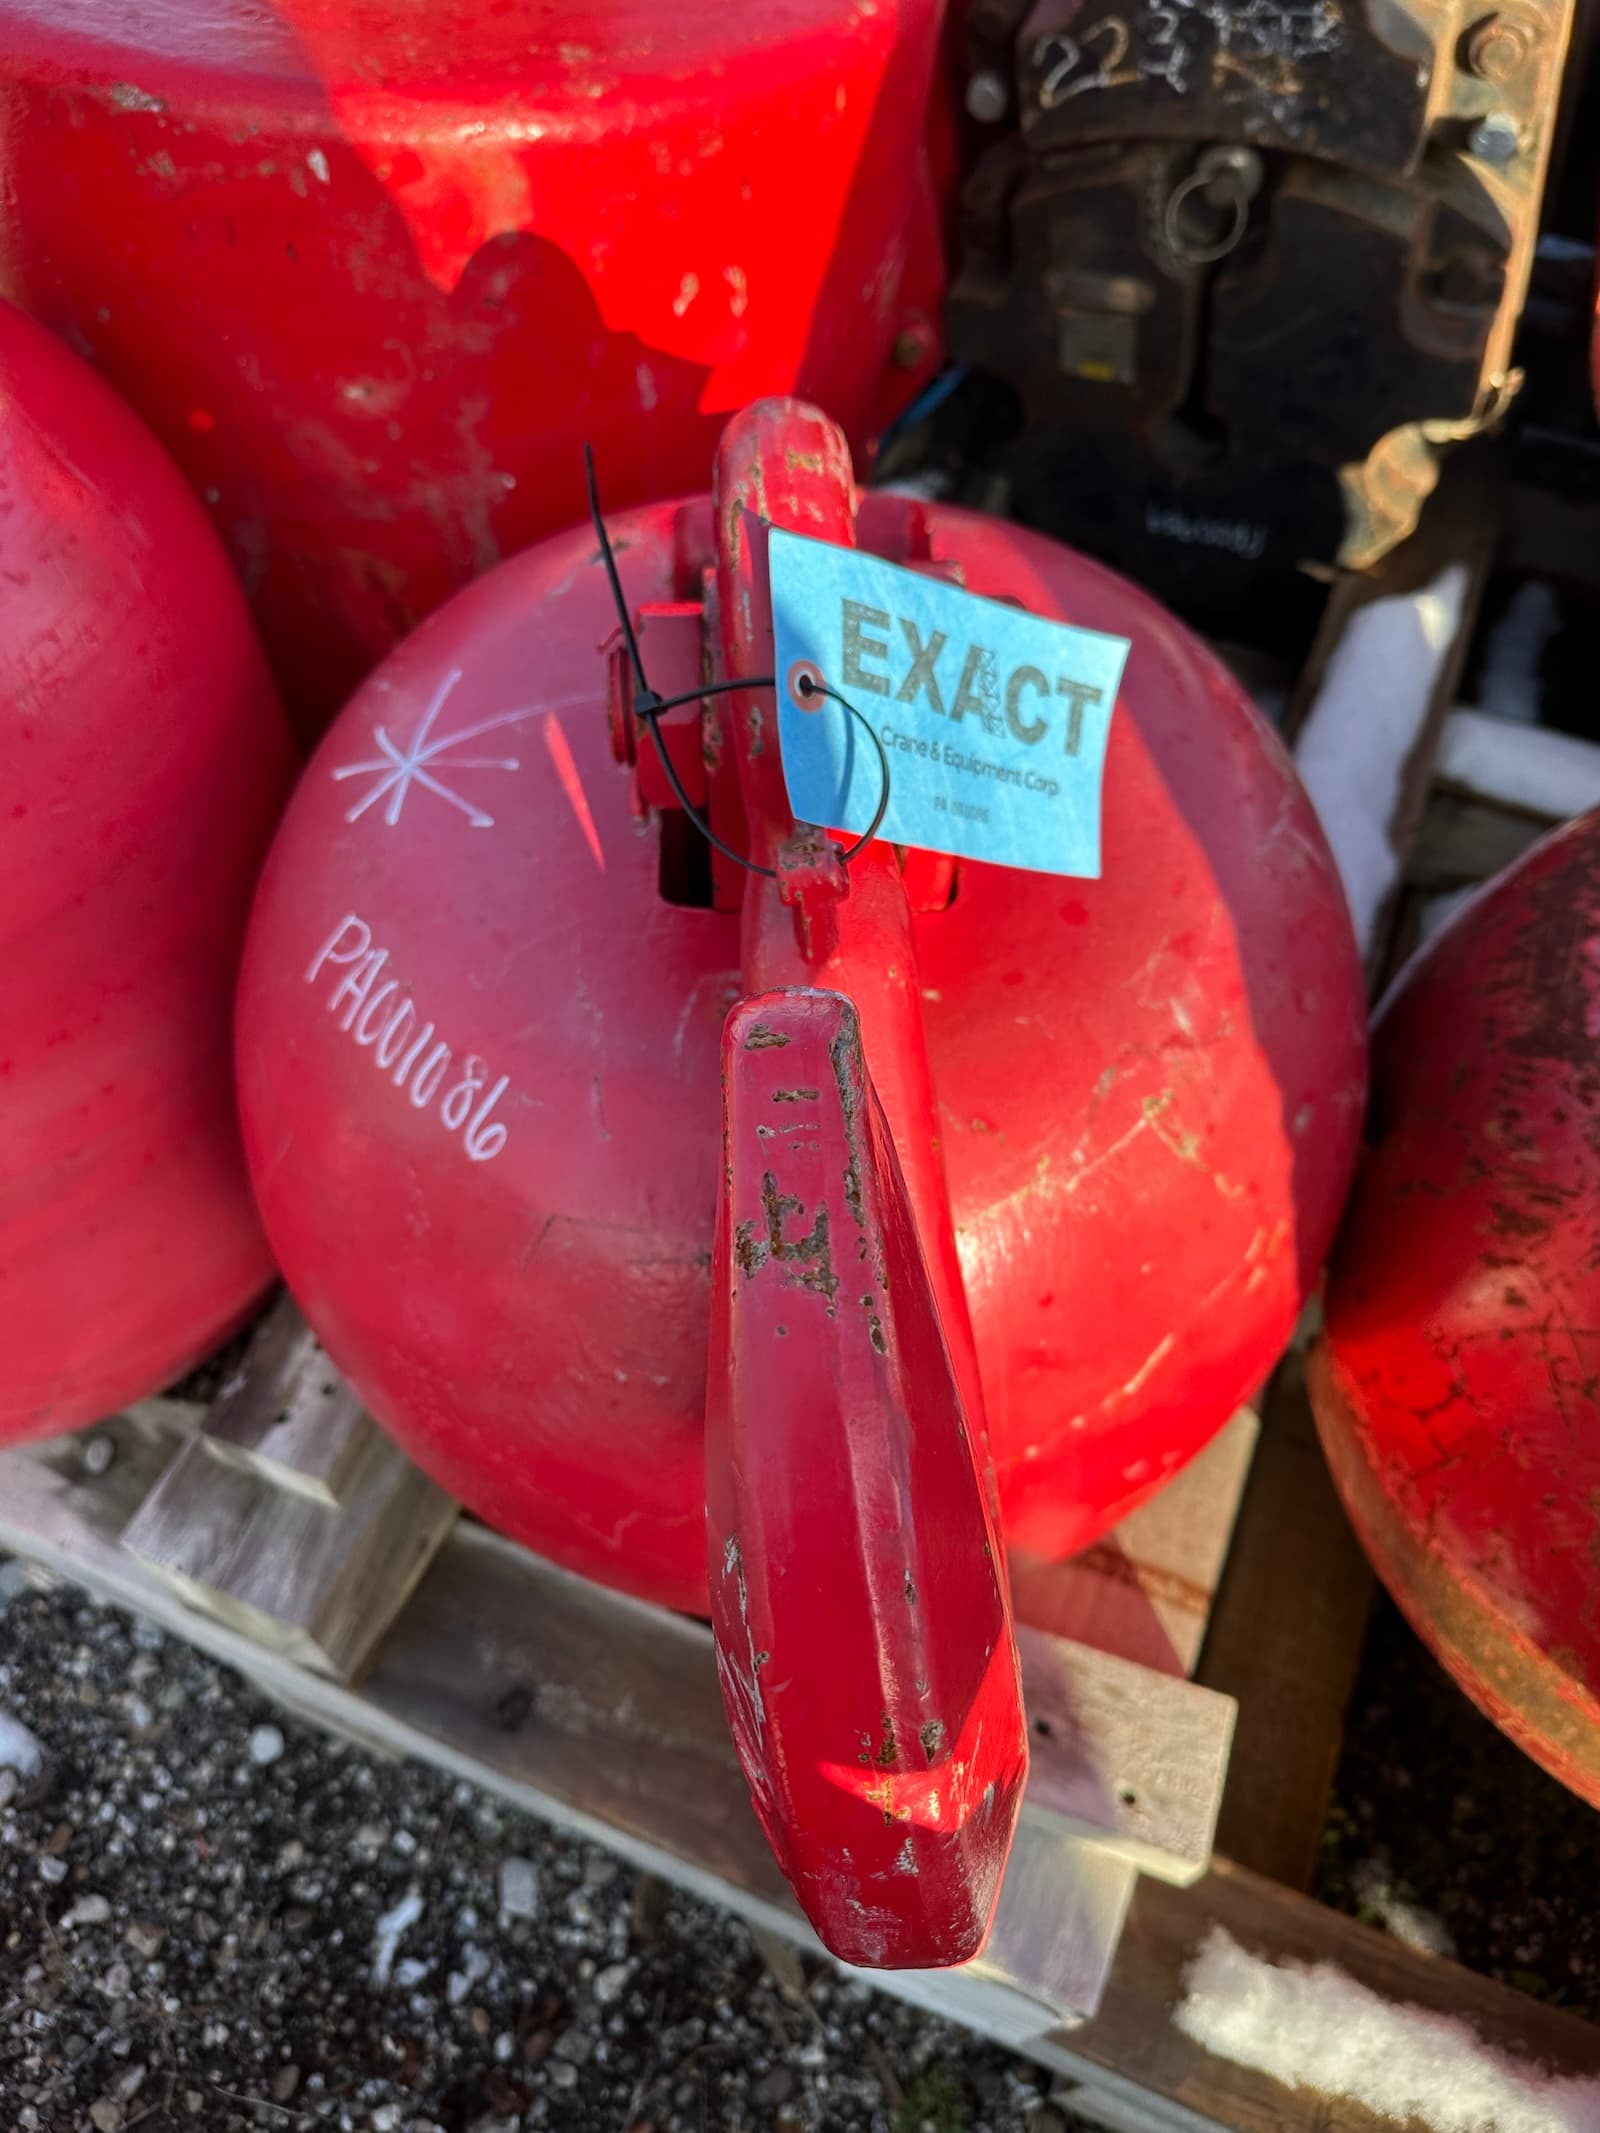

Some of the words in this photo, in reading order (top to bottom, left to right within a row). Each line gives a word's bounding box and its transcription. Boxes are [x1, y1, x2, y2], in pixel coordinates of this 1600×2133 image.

[841, 598, 1105, 757] EXACT
[880, 726, 928, 758] Crane
[930, 741, 941, 762] &
[943, 745, 1023, 788] Equipment
